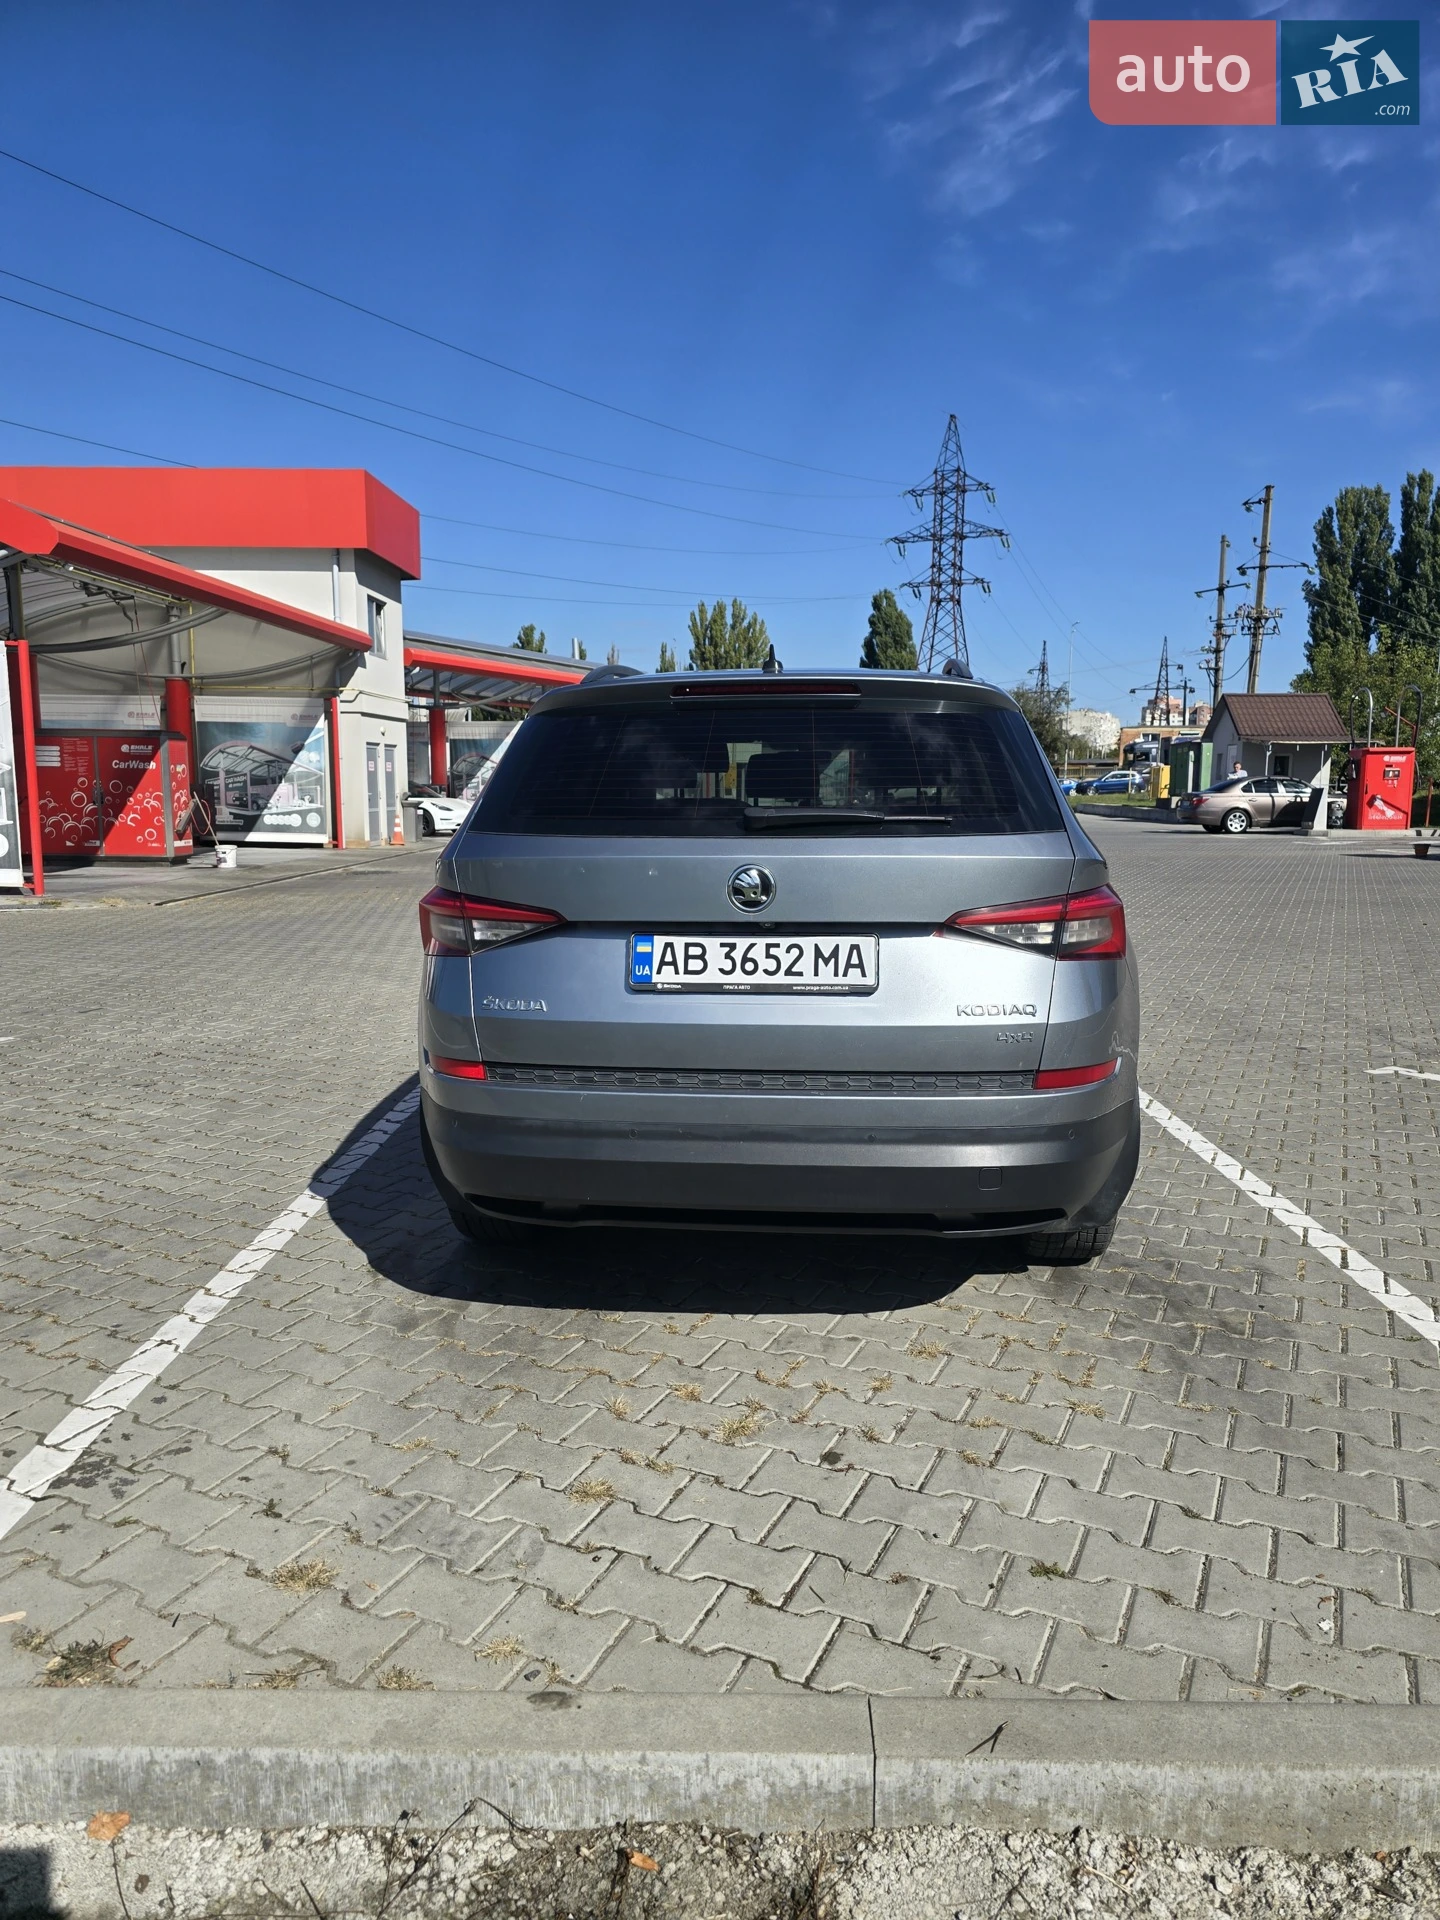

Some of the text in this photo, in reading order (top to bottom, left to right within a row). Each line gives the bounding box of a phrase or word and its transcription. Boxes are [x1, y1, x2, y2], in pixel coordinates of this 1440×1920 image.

[111, 759, 157, 770] CarWash
[656, 942, 867, 978] AB 3652 MA
[635, 965, 650, 976] UA
[956, 1004, 1037, 1018] KODIAQ
